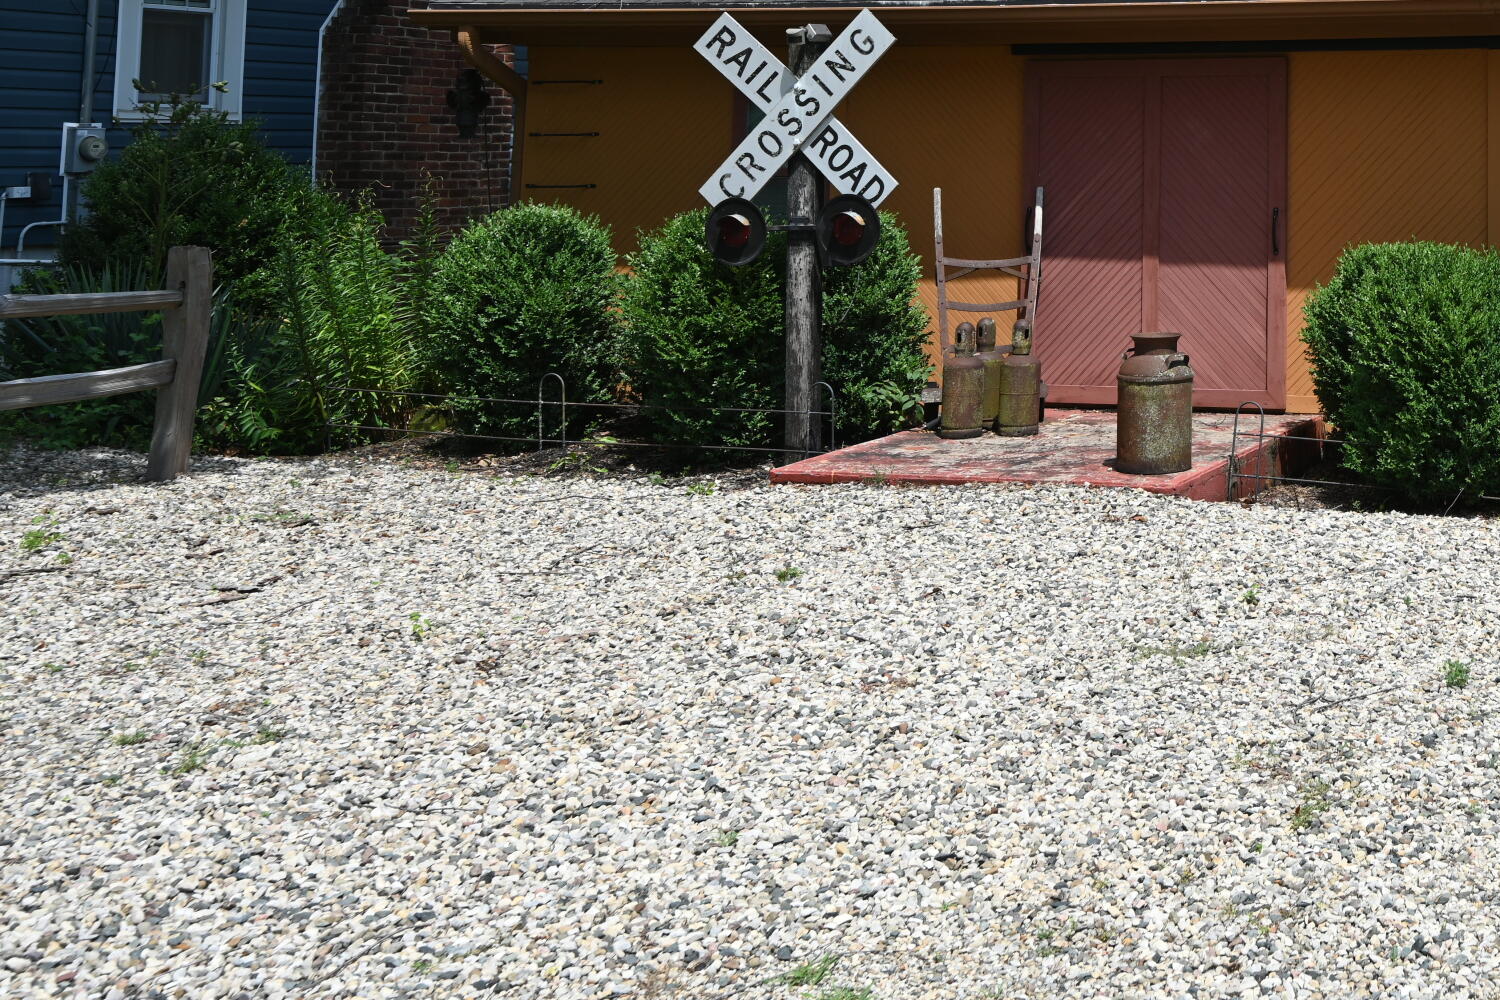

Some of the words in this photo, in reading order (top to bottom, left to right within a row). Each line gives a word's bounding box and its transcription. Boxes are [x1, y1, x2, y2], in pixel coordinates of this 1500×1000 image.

[705, 25, 779, 104] RAIL
[809, 125, 885, 204] ROAD
[719, 28, 875, 199] CROSSING
